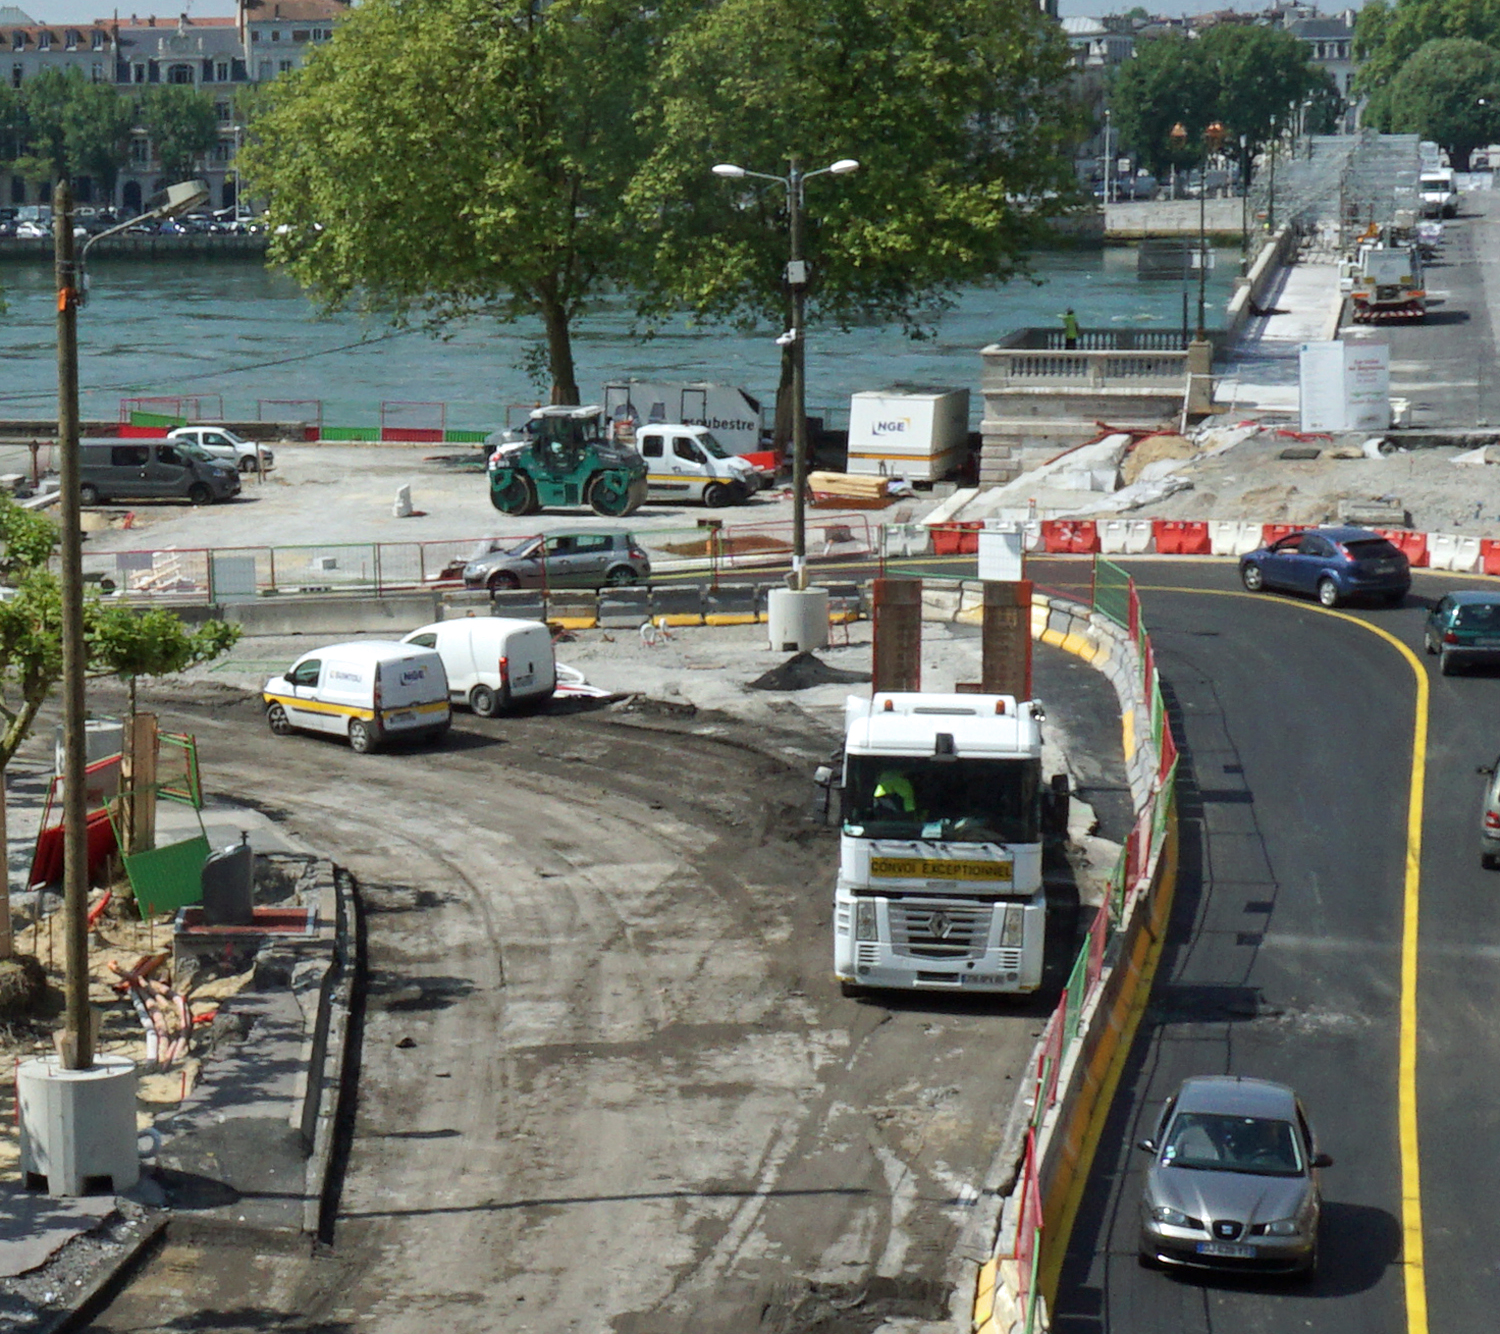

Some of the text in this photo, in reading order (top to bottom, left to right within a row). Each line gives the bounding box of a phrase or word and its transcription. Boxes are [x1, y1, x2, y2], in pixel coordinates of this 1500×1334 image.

[877, 420, 906, 433] NGE
[871, 861, 1012, 878] CONVOI EXCEPTIONNEL
